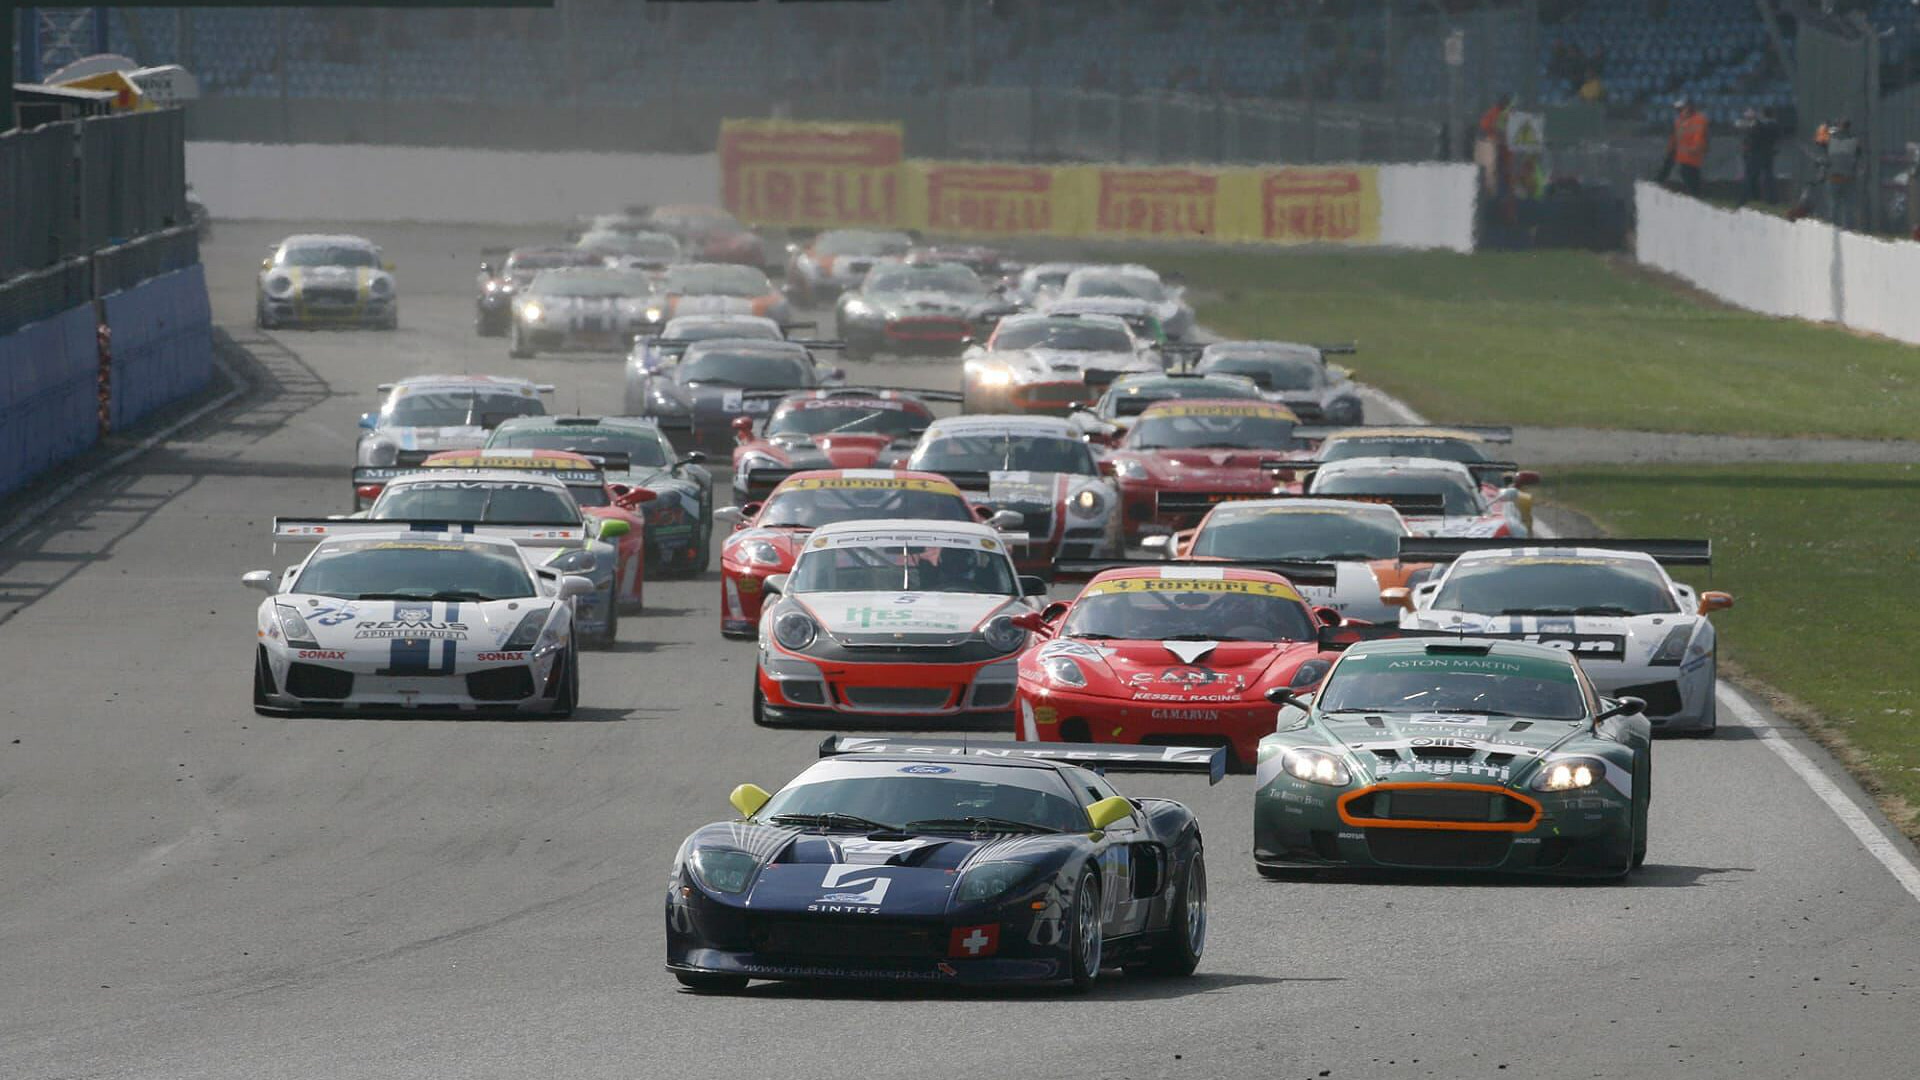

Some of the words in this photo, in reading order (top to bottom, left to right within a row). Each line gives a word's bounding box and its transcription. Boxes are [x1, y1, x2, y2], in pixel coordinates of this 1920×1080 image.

[837, 535, 971, 545] PORSCHE
[1143, 579, 1249, 592] Ferrari
[355, 621, 469, 631] REMUS
[298, 650, 347, 660] SONAX
[478, 652, 525, 662] SONAX
[1388, 659, 1450, 669] ASTON
[1453, 659, 1521, 672] MARTIN
[1132, 692, 1186, 701] KESSEL
[1151, 708, 1218, 720] GAMARVIN
[906, 747, 1139, 761] SINTEZ
[1375, 763, 1510, 780] BARBETTI
[807, 904, 881, 914] SINTEZ
